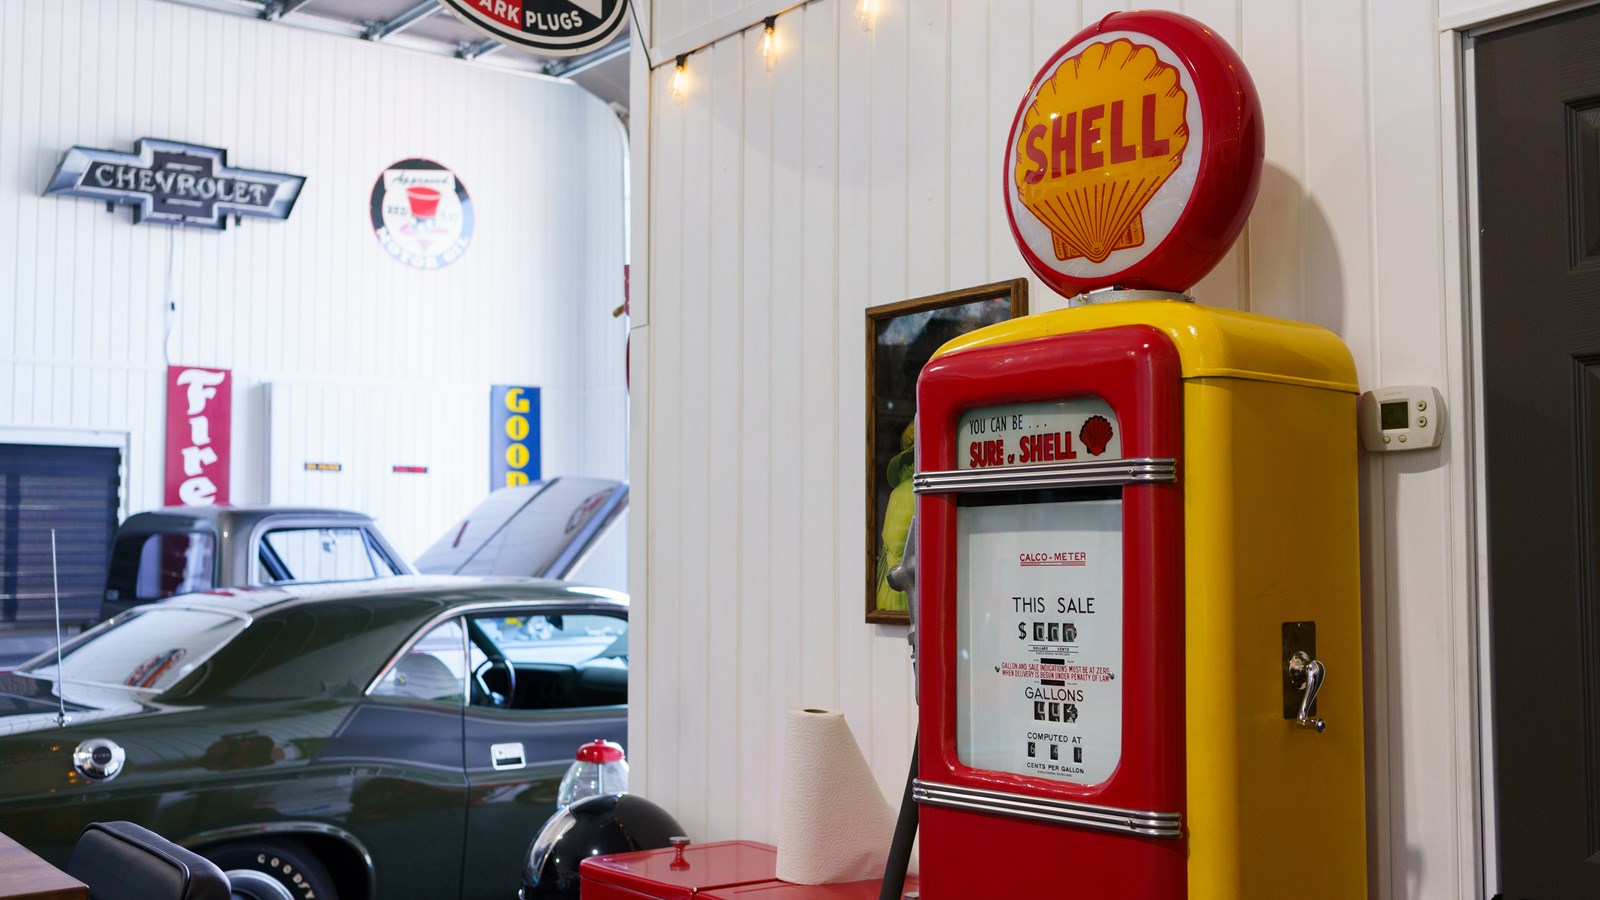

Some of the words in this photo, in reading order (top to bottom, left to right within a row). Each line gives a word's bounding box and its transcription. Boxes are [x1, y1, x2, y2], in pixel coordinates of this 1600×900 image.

[525, 10, 584, 31] PLUGS
[1024, 93, 1170, 185] SHELL
[94, 164, 268, 206] CHEVROLET
[969, 418, 986, 435] YOU
[990, 415, 1007, 433] CAN
[1012, 414, 1024, 430] BE
[176, 368, 226, 506] Fire
[969, 439, 1004, 468] SURE
[1019, 431, 1077, 463] SHELL
[1012, 597, 1045, 613] THIS
[1057, 597, 1096, 614] SALE
[1018, 621, 1027, 641] $
[1001, 662, 1018, 670] GALLON
[1018, 663, 1028, 671] AND
[1040, 664, 1068, 673] INDICATIONS
[1068, 666, 1081, 674] MUST
[1082, 666, 1088, 674] BE
[1014, 670, 1035, 678] DELIVERY
[1040, 671, 1055, 679] BEGUN
[1055, 672, 1070, 680] UNDER
[1071, 673, 1092, 681] PENALTY
[1092, 674, 1099, 682] OF
[1025, 687, 1084, 702] GALLONS
[1027, 732, 1069, 743] COMPUTED
[1072, 736, 1082, 744] AT
[1061, 766, 1084, 774] GALLON
